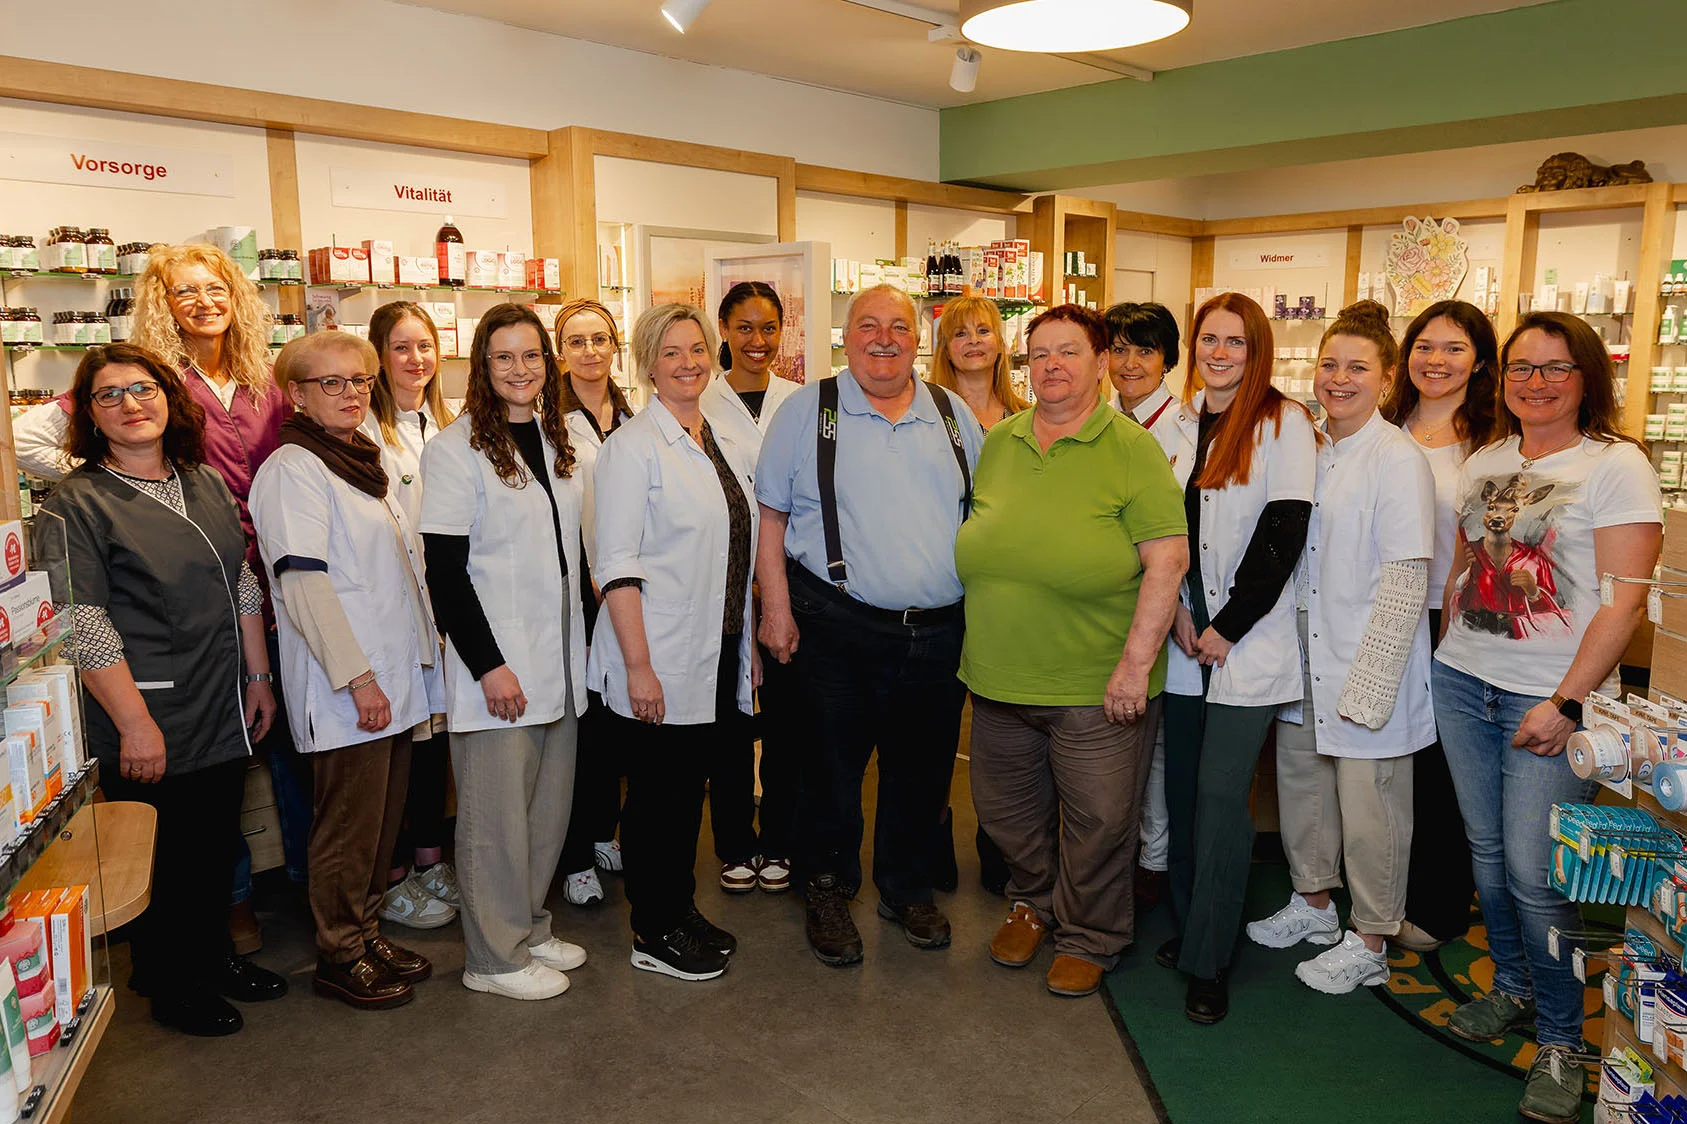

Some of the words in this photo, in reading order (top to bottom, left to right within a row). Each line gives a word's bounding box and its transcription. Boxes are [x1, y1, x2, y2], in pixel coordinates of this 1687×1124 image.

[70, 153, 168, 180] Vorsorge
[393, 184, 453, 203] Vitalität
[1260, 254, 1294, 263] Widmer
